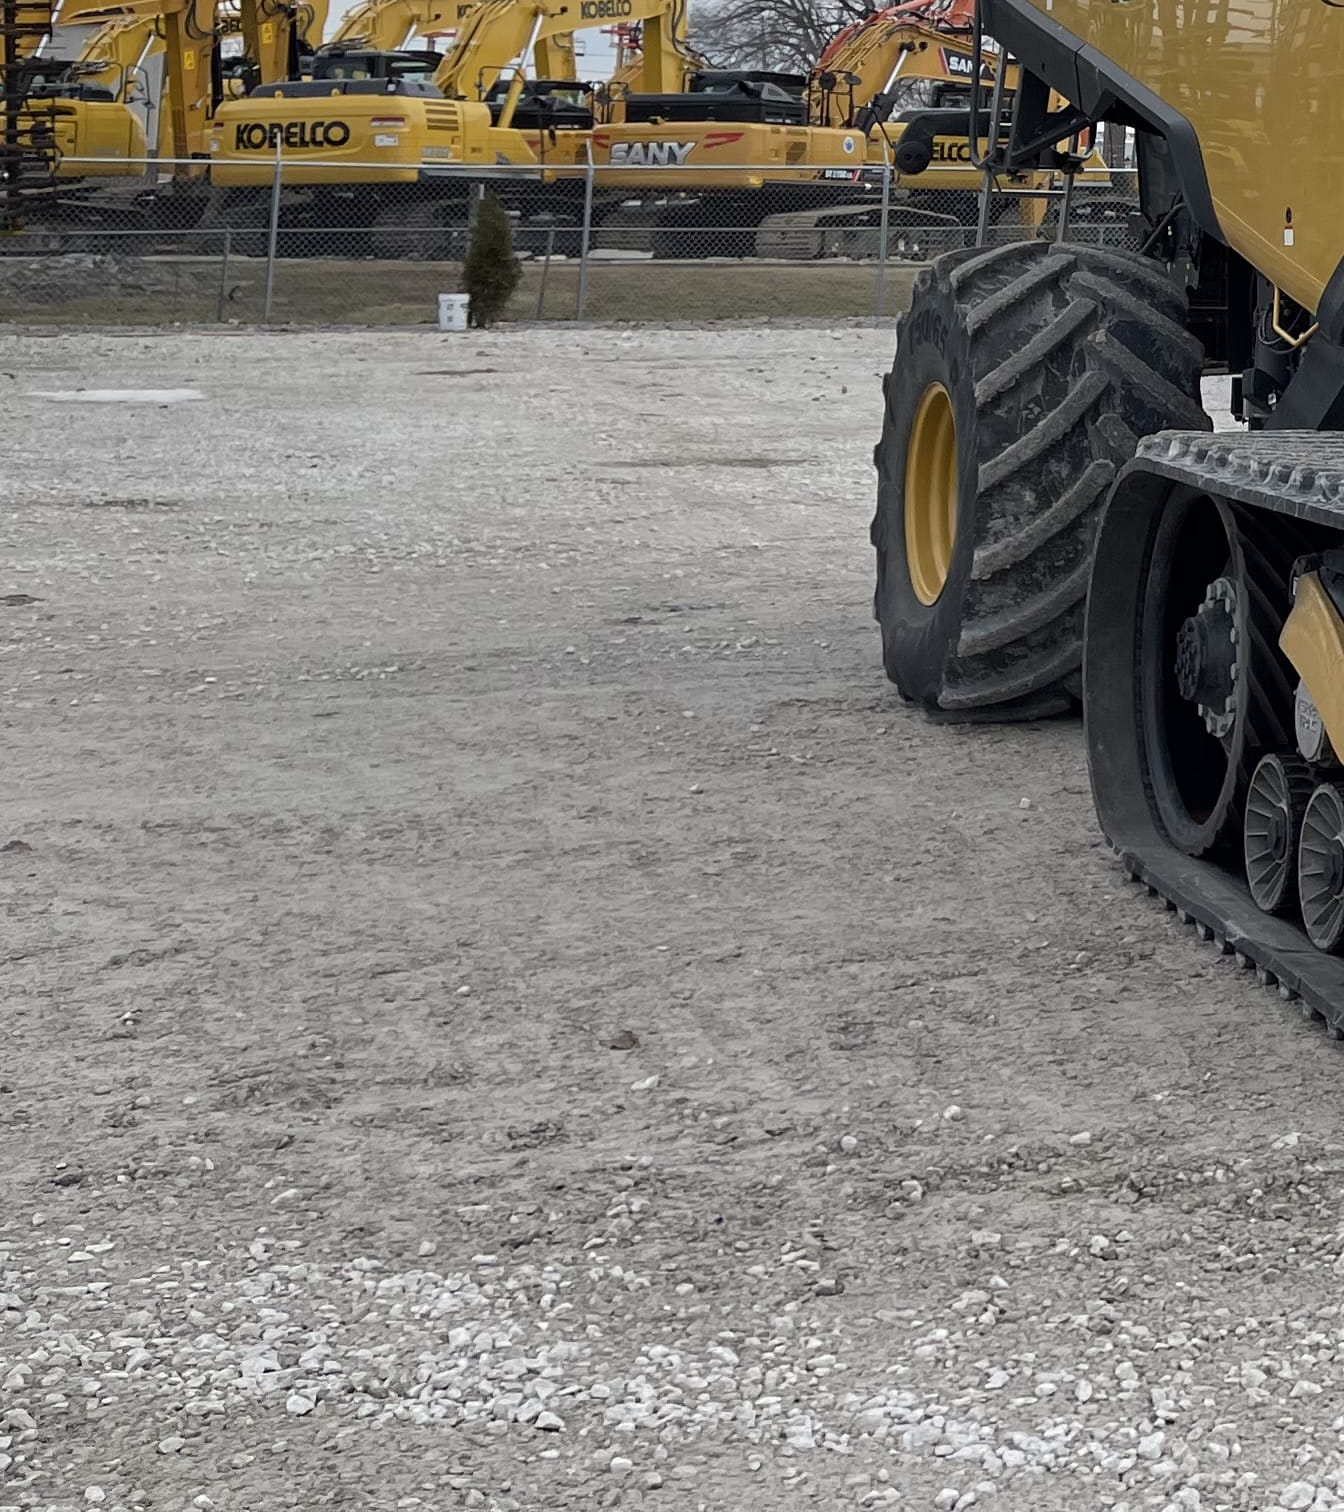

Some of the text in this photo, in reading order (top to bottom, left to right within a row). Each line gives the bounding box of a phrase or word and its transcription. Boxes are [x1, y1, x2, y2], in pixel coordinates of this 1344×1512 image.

[580, 0, 632, 20] KOBELCO
[235, 121, 351, 151] KOBELCO
[610, 141, 697, 166] SANY
